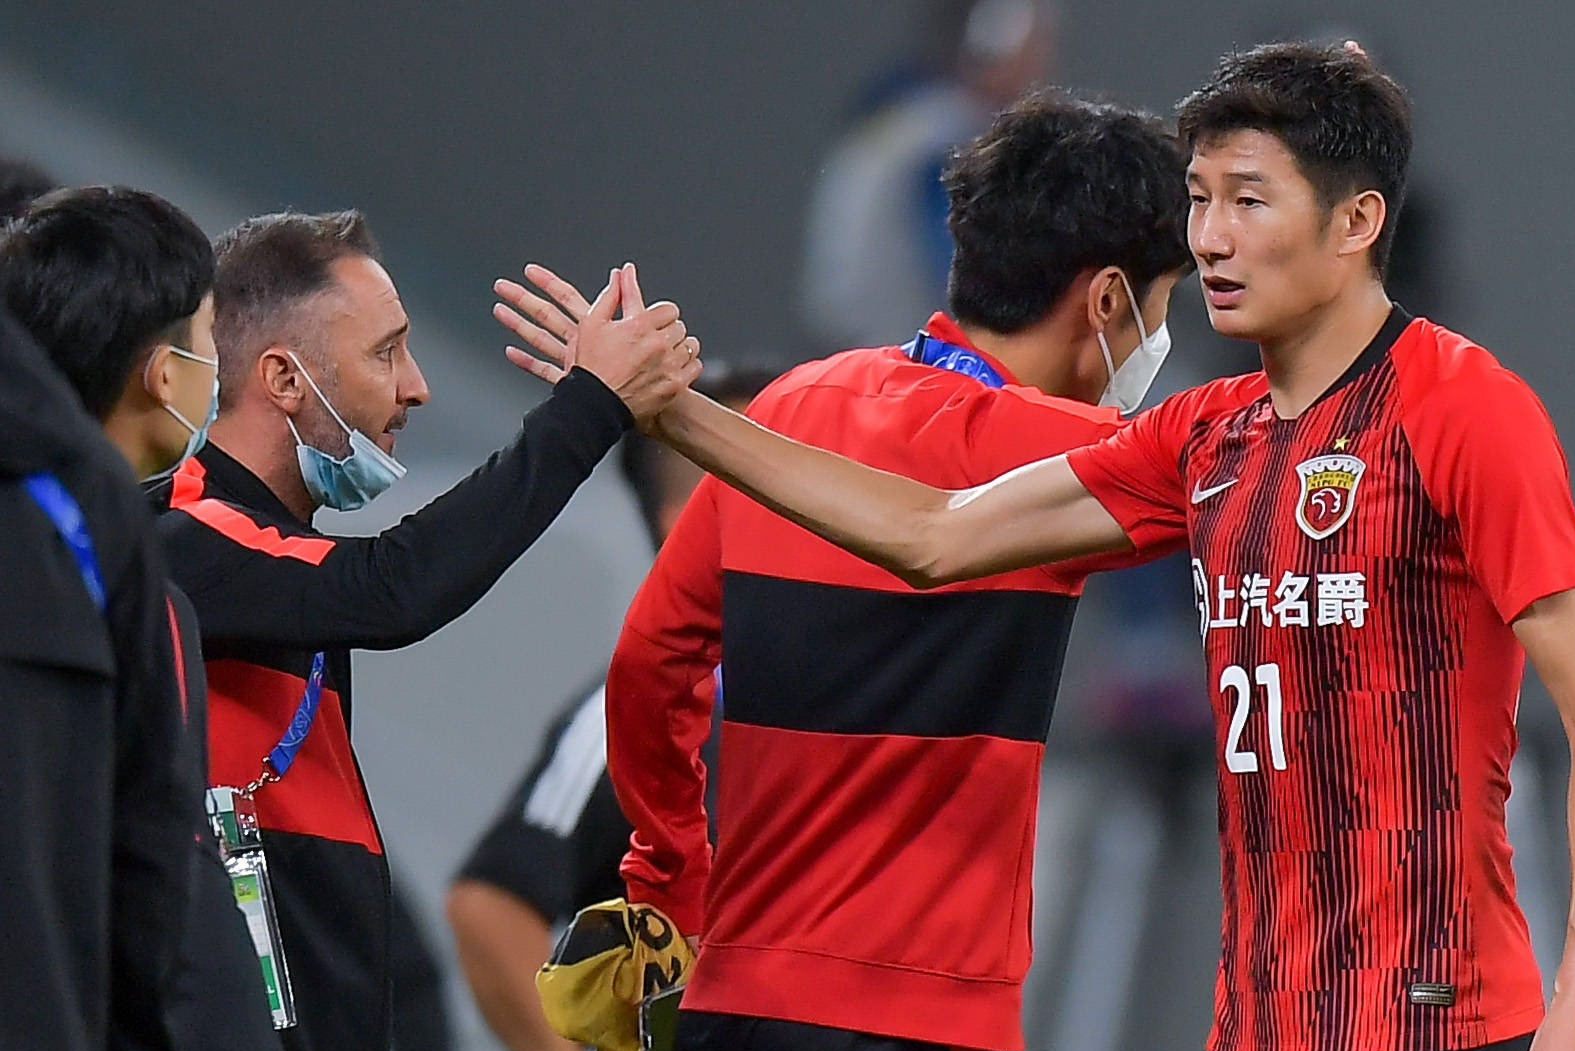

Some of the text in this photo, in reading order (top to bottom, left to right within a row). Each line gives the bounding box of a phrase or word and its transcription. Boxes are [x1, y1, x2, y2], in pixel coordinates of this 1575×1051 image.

[1210, 570, 1370, 629] 上汽名爵
[1219, 663, 1288, 773] 21
